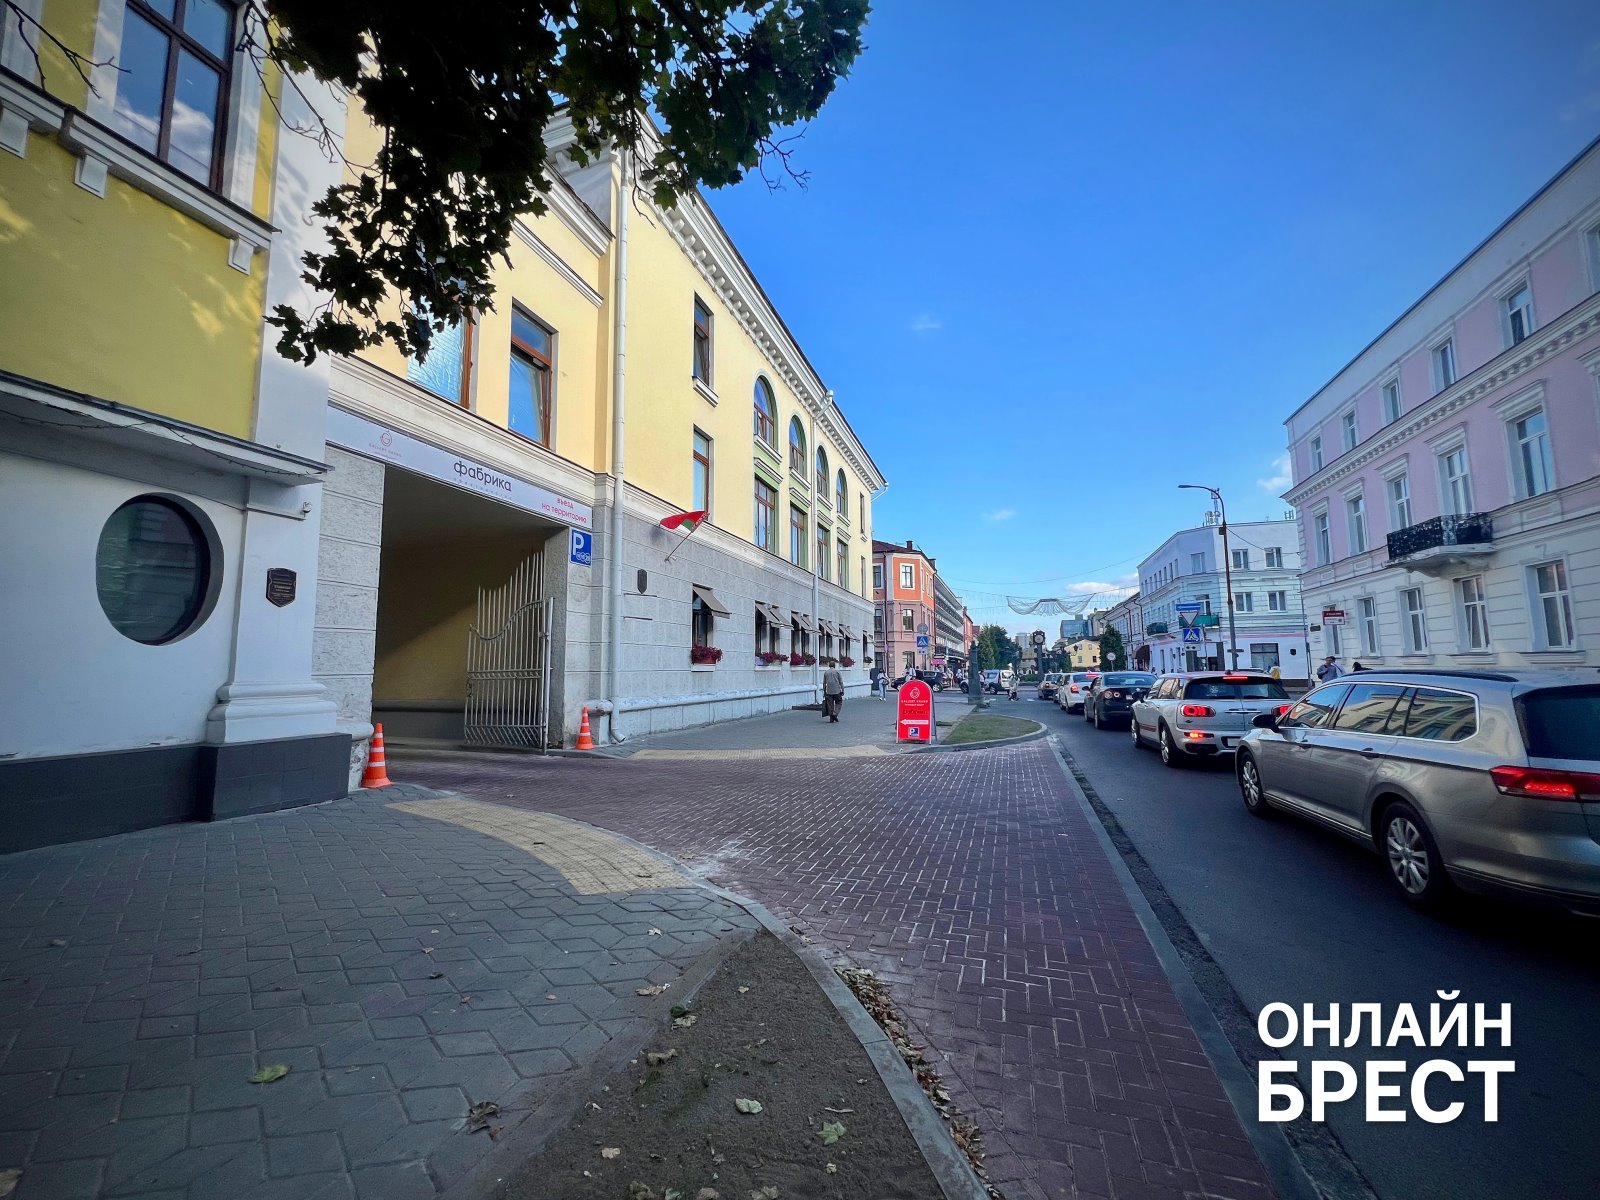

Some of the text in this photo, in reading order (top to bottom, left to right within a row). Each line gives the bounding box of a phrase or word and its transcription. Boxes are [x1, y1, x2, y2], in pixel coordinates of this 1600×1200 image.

[453, 461, 512, 492] фабрика
[541, 503, 587, 524] на территорию
[557, 498, 574, 509] въезд
[572, 532, 585, 555] P
